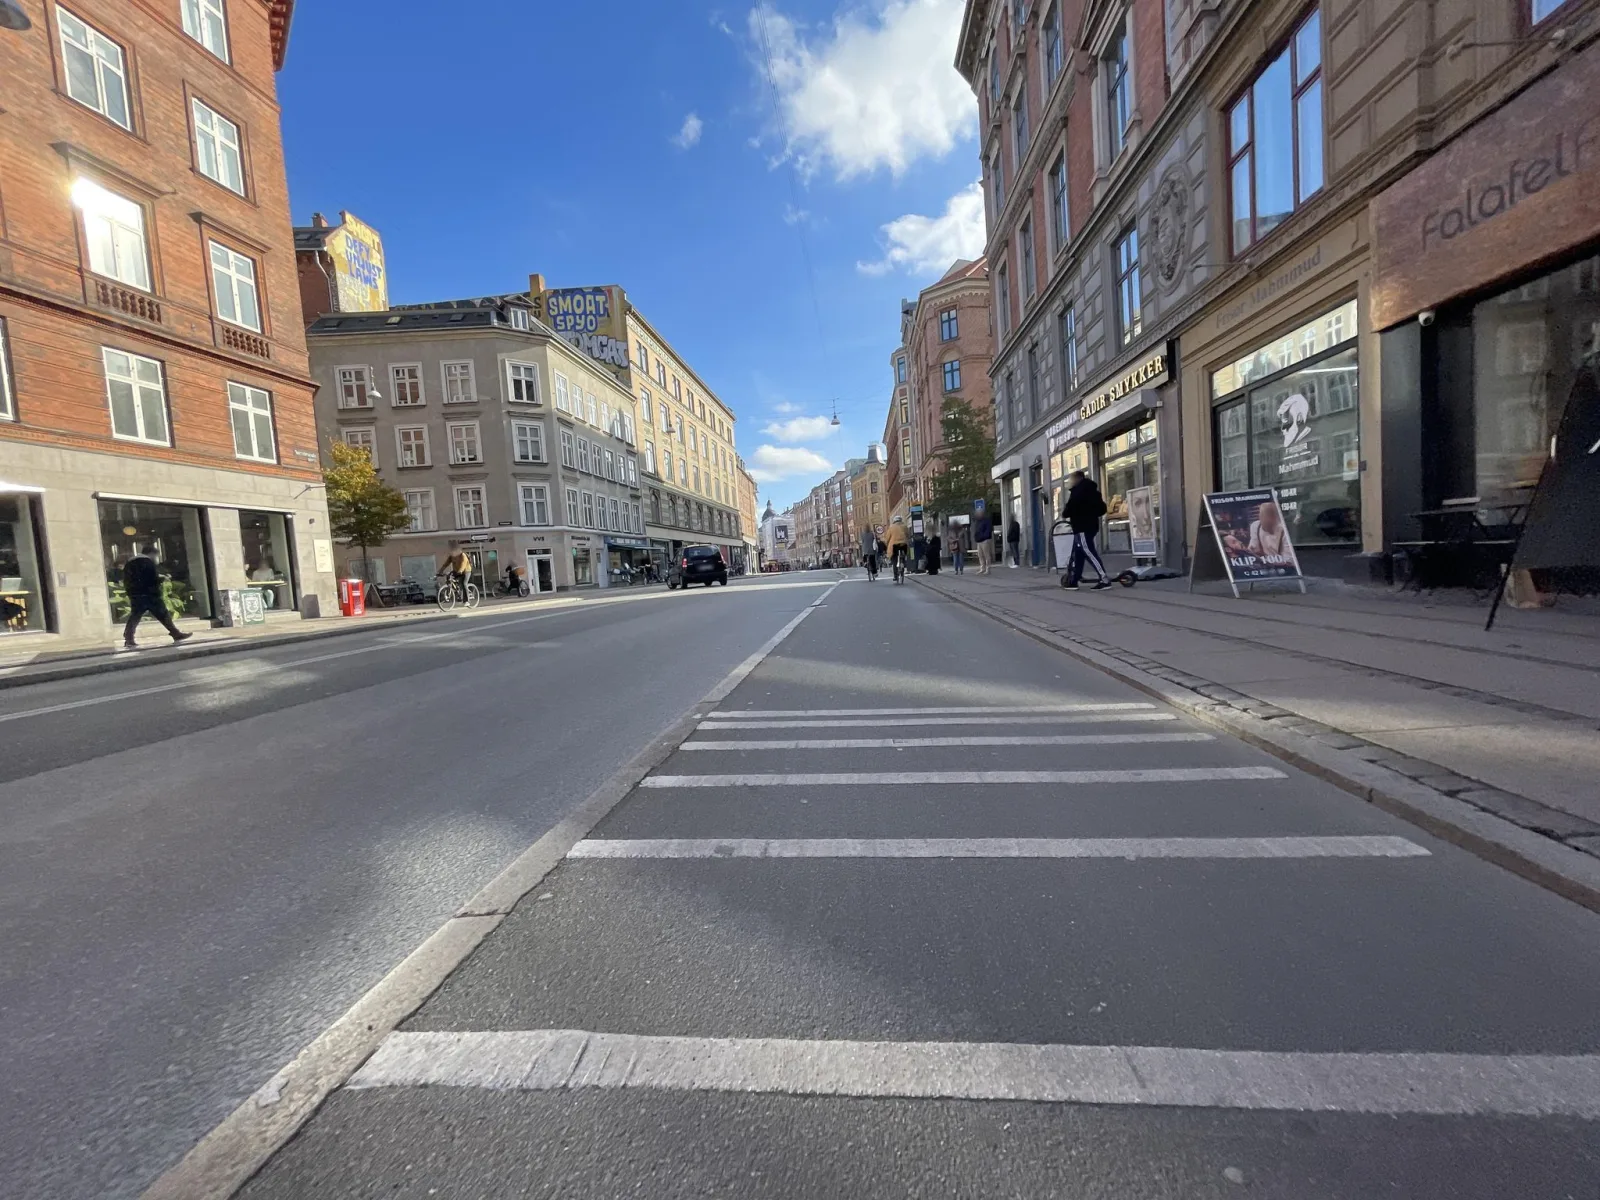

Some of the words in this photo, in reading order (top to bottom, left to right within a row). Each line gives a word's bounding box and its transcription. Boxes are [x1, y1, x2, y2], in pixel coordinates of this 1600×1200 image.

[345, 234, 370, 257] DEFY
[349, 262, 378, 289] LAWS
[548, 294, 606, 316] SMOAT
[556, 314, 596, 331] SPYO
[1080, 394, 1106, 420] GADIR
[1110, 355, 1163, 402] SMYKKER
[1231, 556, 1256, 567] KLIP
